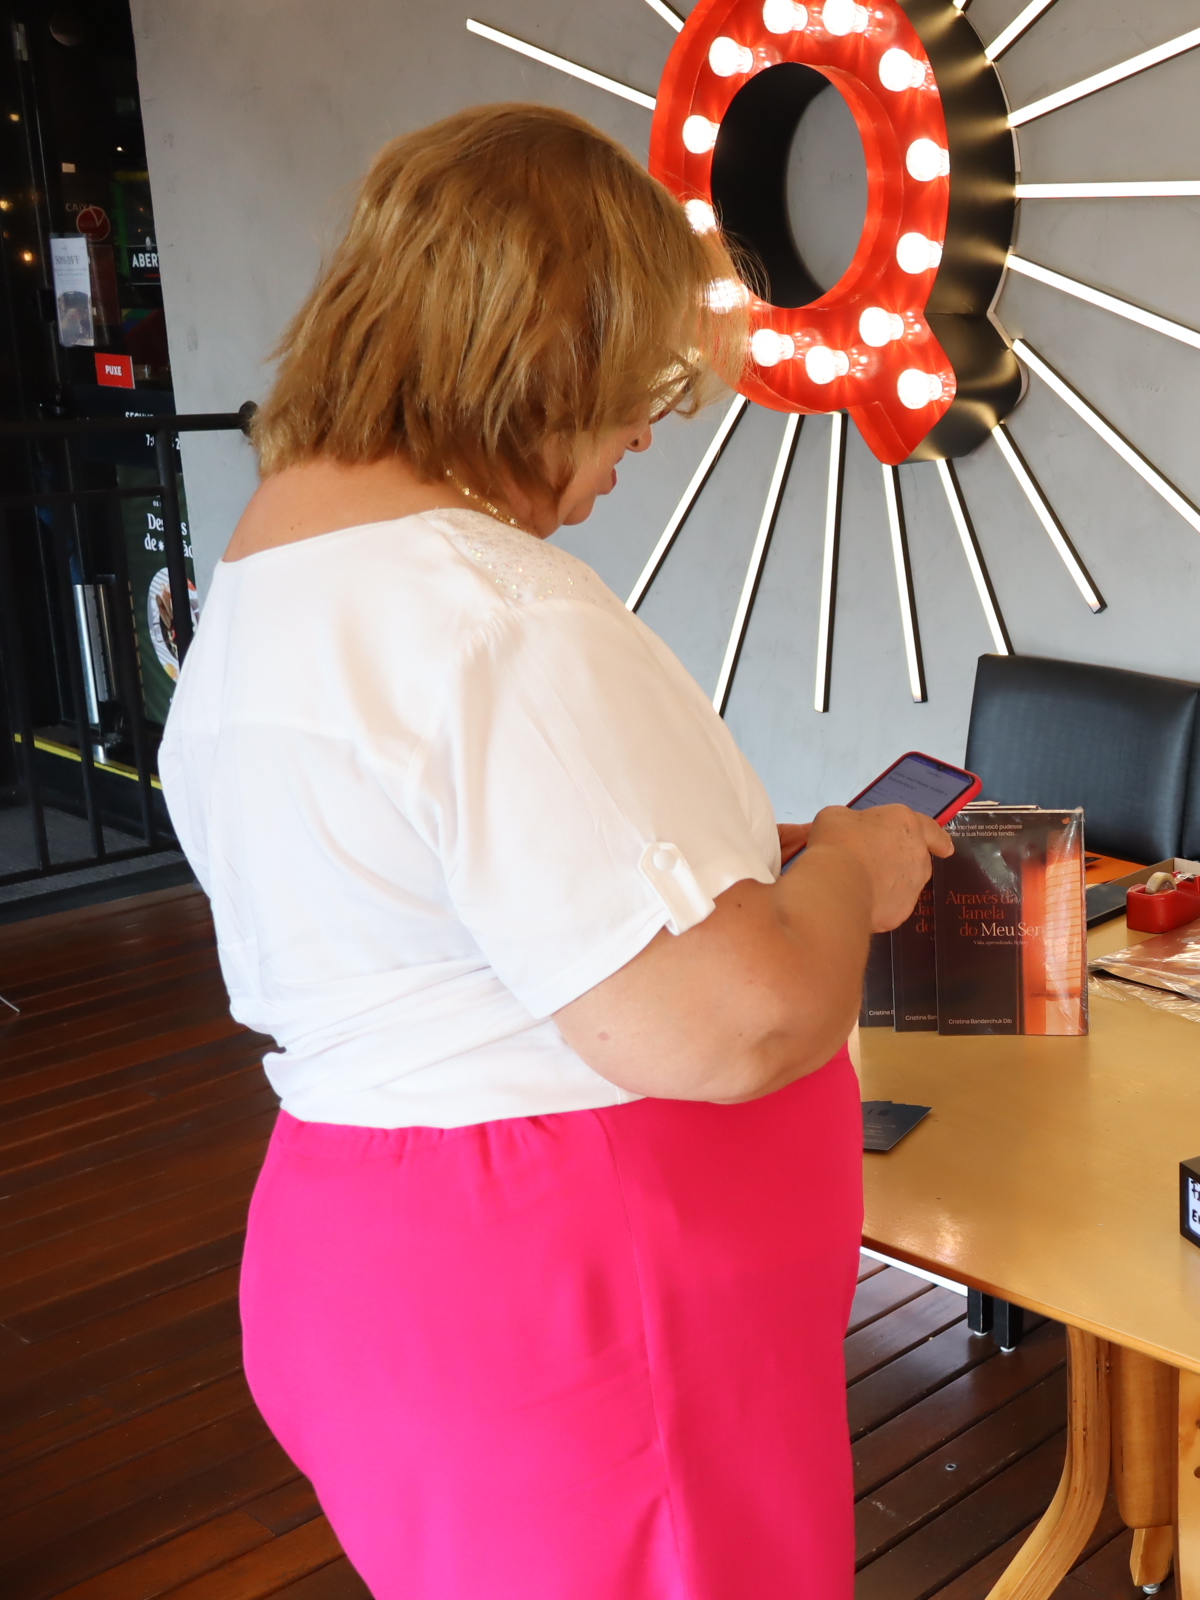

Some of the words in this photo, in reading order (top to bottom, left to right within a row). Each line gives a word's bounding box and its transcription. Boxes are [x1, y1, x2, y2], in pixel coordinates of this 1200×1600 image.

[105, 365, 122, 377] PUXE
[144, 533, 157, 551] de
[945, 890, 998, 905] Através
[1001, 889, 1019, 905] da
[958, 905, 1005, 920] Janela
[960, 922, 978, 937] do
[981, 922, 1015, 937] Meu
[1017, 922, 1041, 938] Ser
